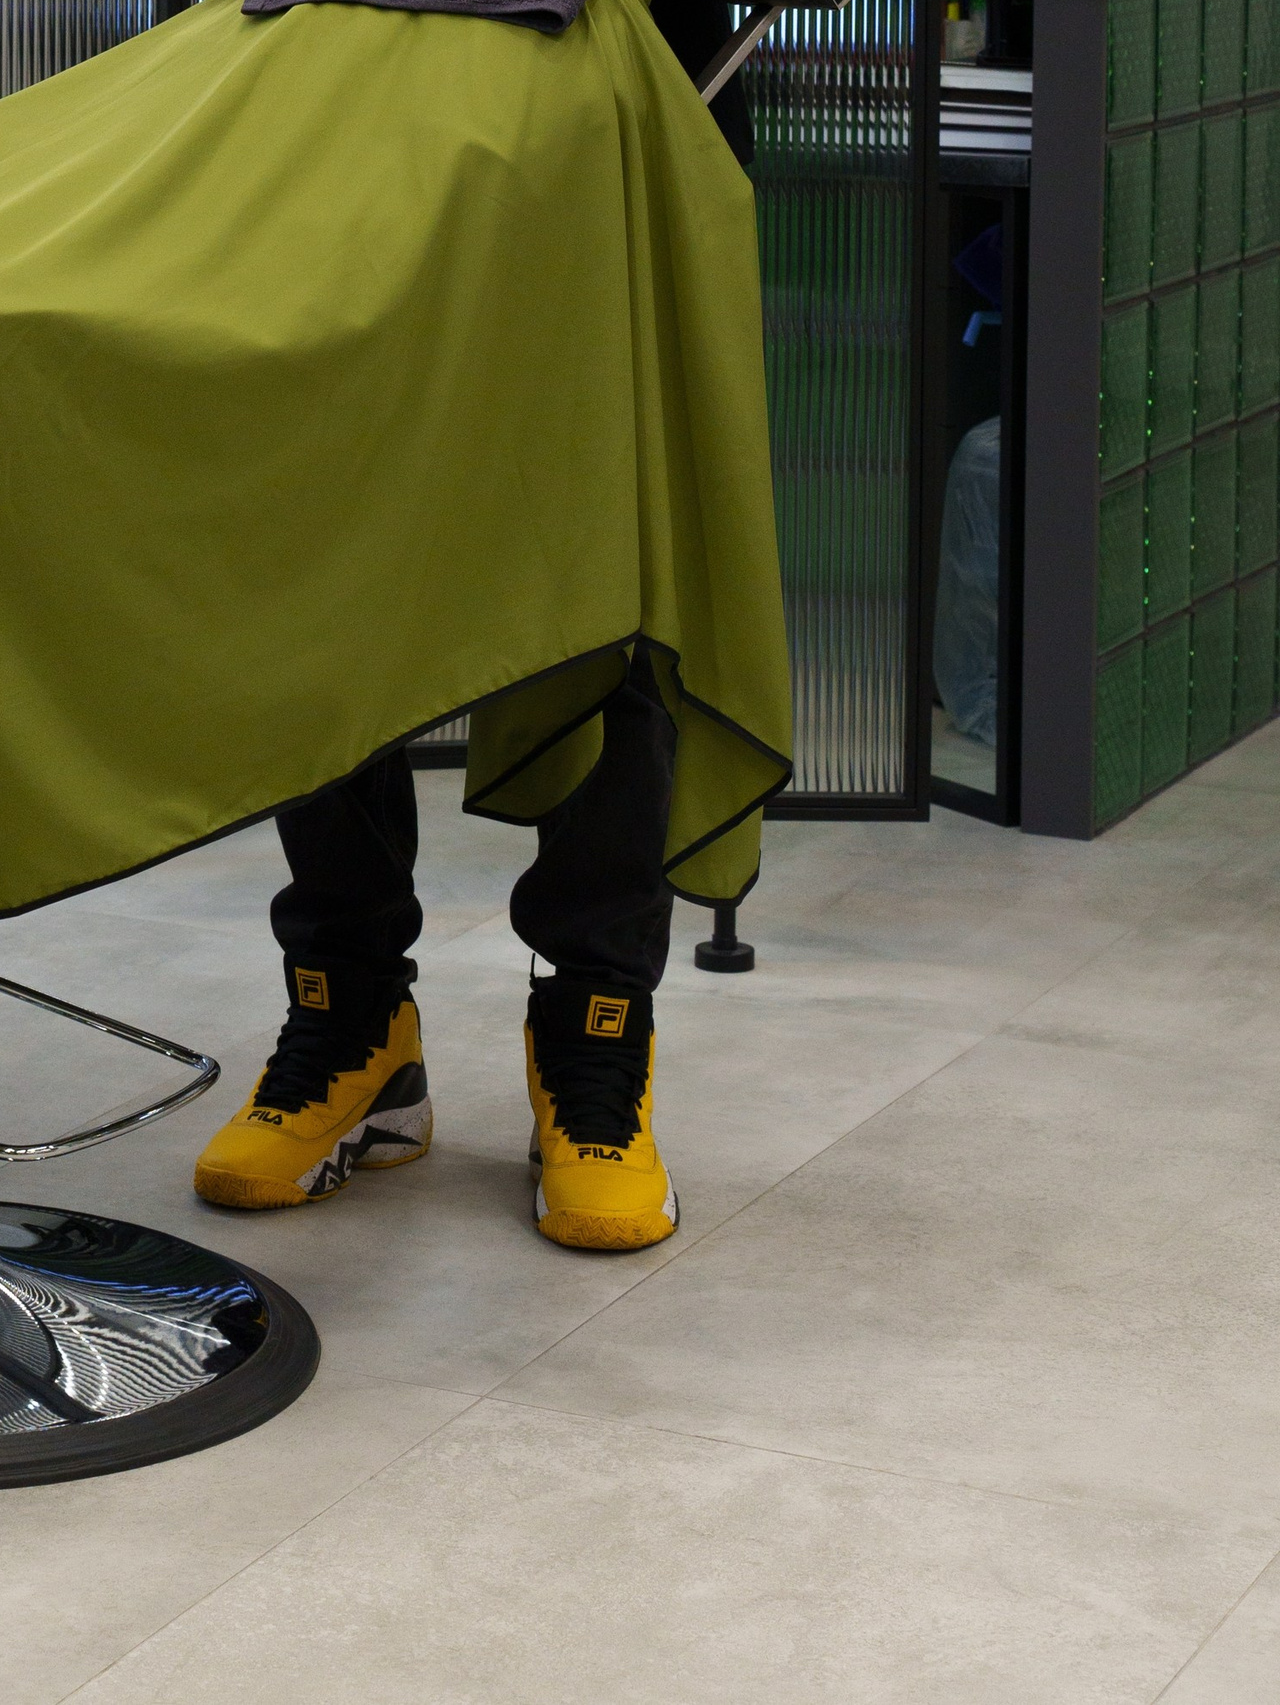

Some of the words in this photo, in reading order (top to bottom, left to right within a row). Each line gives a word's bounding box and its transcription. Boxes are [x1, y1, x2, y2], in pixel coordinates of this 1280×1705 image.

[595, 1005, 621, 1029] F
[246, 1109, 283, 1126] FILA
[577, 1147, 624, 1162] FILA
